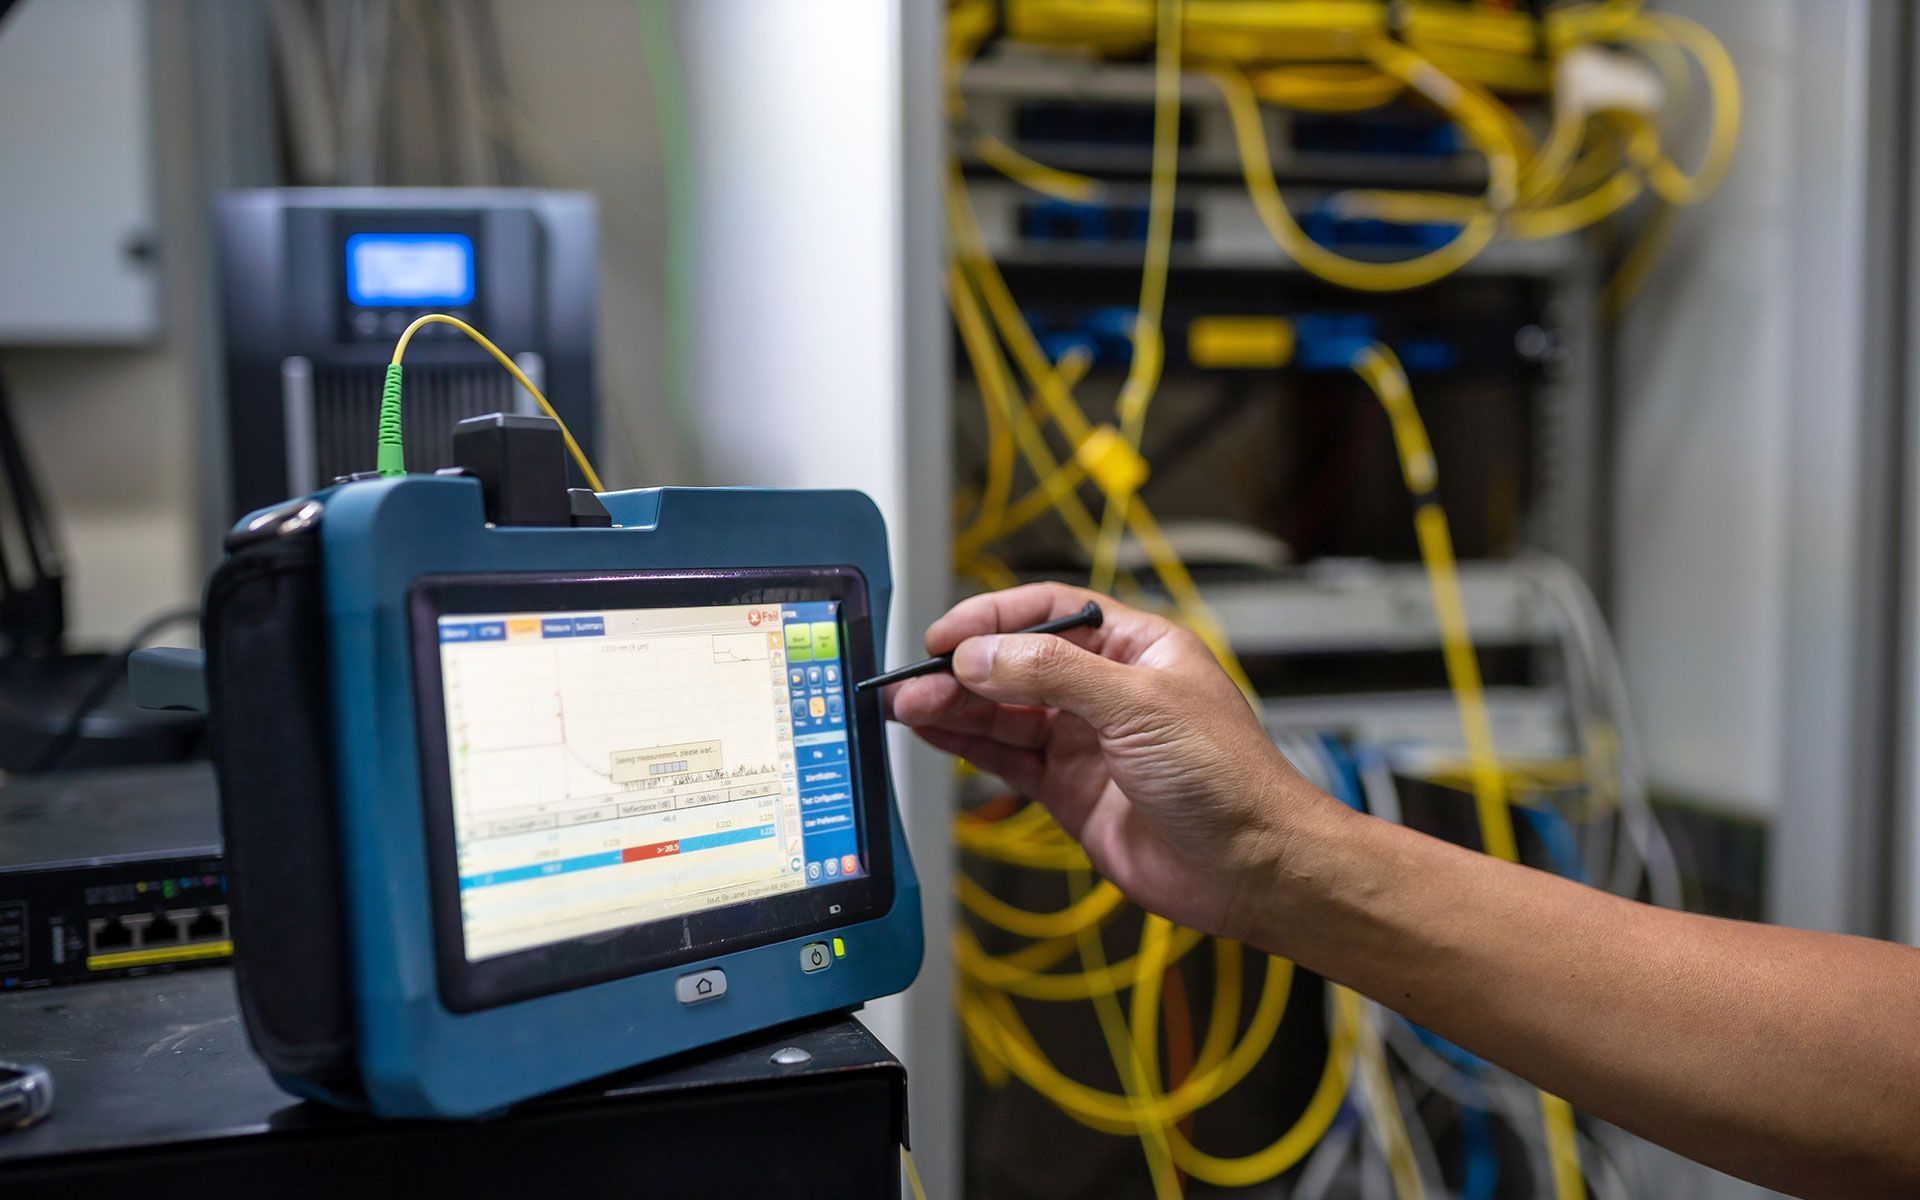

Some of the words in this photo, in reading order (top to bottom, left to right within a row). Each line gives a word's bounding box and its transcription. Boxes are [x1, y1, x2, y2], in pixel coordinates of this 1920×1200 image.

[762, 611, 779, 620] Fail
[576, 622, 603, 632] Summary
[680, 748, 699, 758] please
